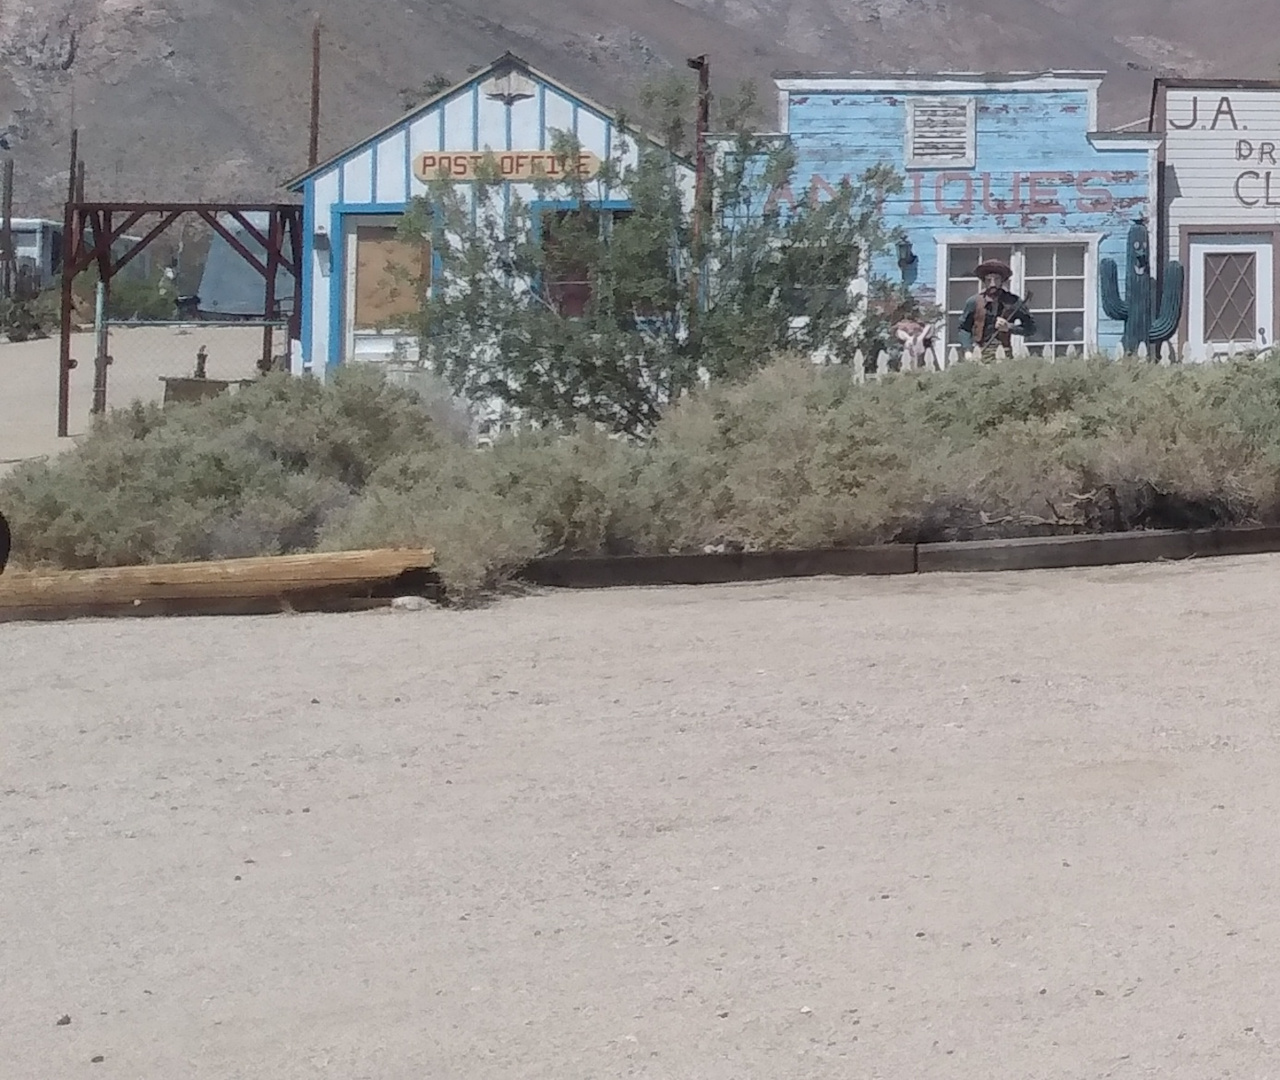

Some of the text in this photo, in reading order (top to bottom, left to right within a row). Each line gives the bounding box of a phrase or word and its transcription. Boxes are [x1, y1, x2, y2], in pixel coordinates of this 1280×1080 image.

[1168, 96, 1248, 131] J.A.
[422, 155, 483, 176] POST
[763, 171, 1113, 216] ANIQUES
